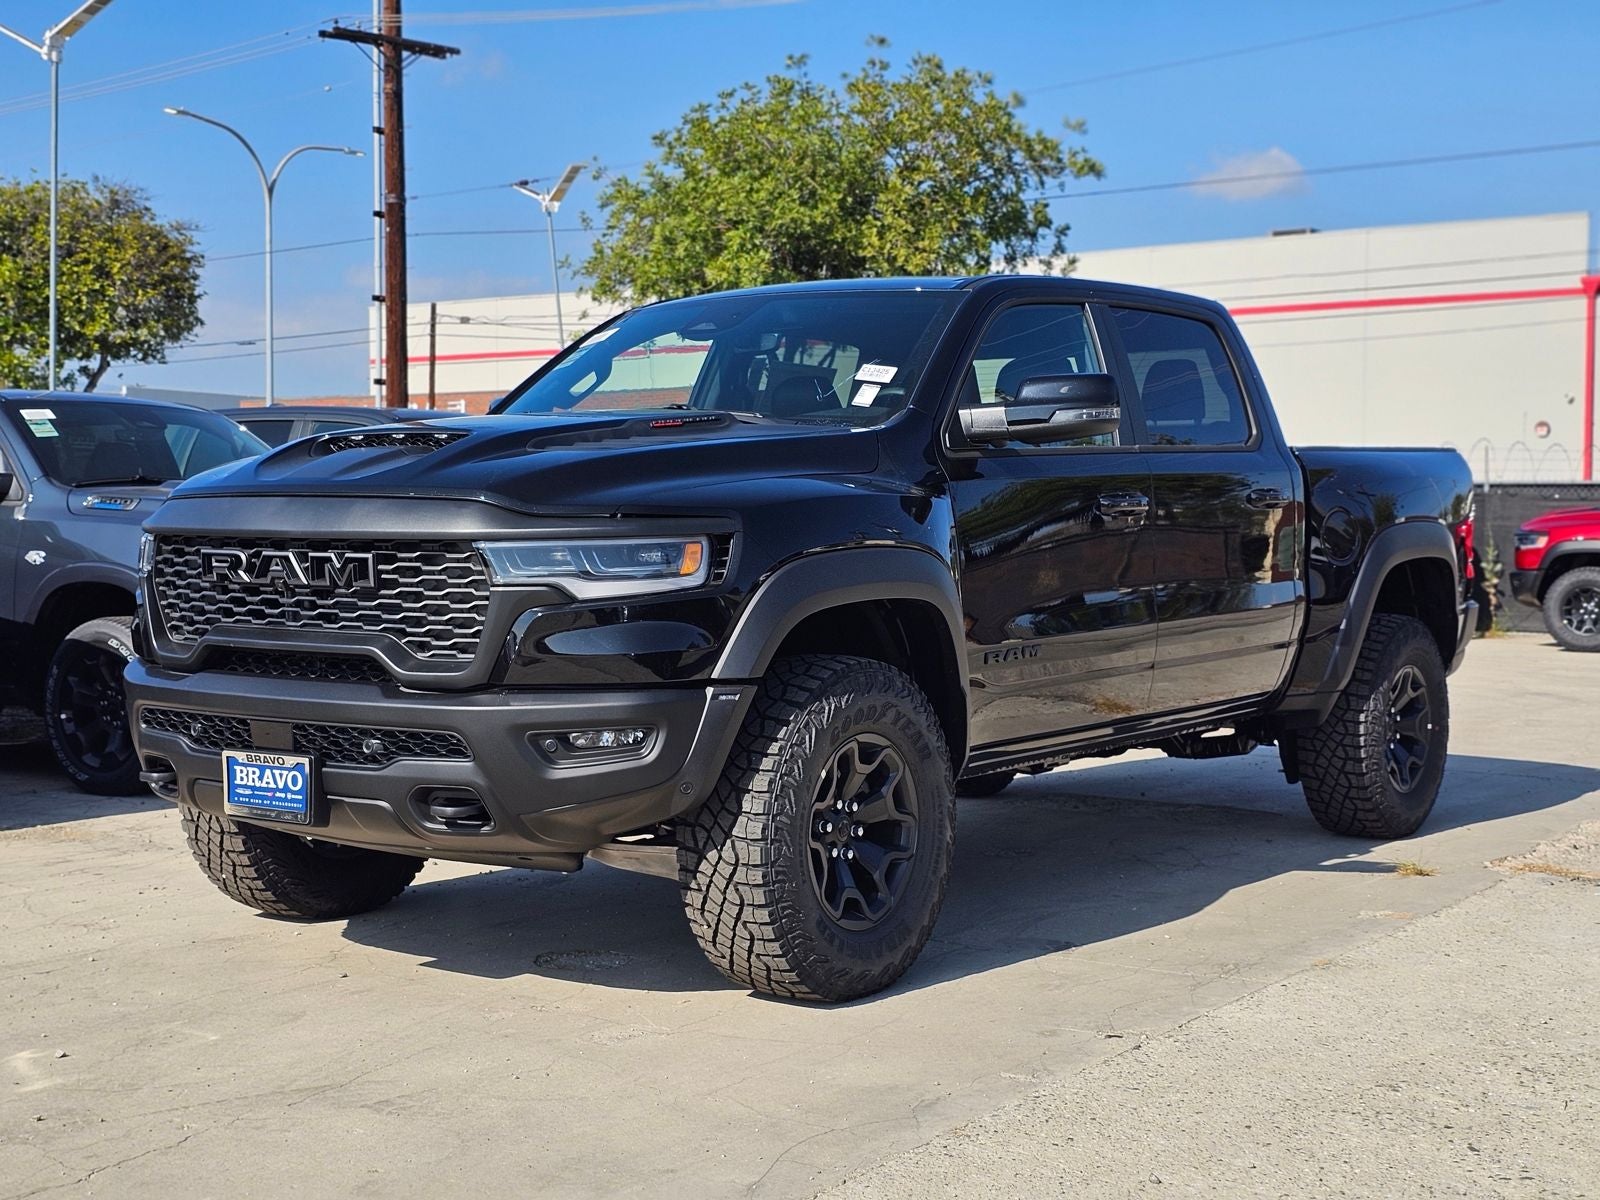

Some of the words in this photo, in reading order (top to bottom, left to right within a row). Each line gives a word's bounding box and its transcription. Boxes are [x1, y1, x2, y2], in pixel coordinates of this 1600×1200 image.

[201, 550, 376, 587] RAM
[983, 644, 1041, 665] RAM
[829, 701, 933, 760] GOODYEAR
[246, 754, 286, 766] BRAVO
[233, 766, 303, 791] BRAVO
